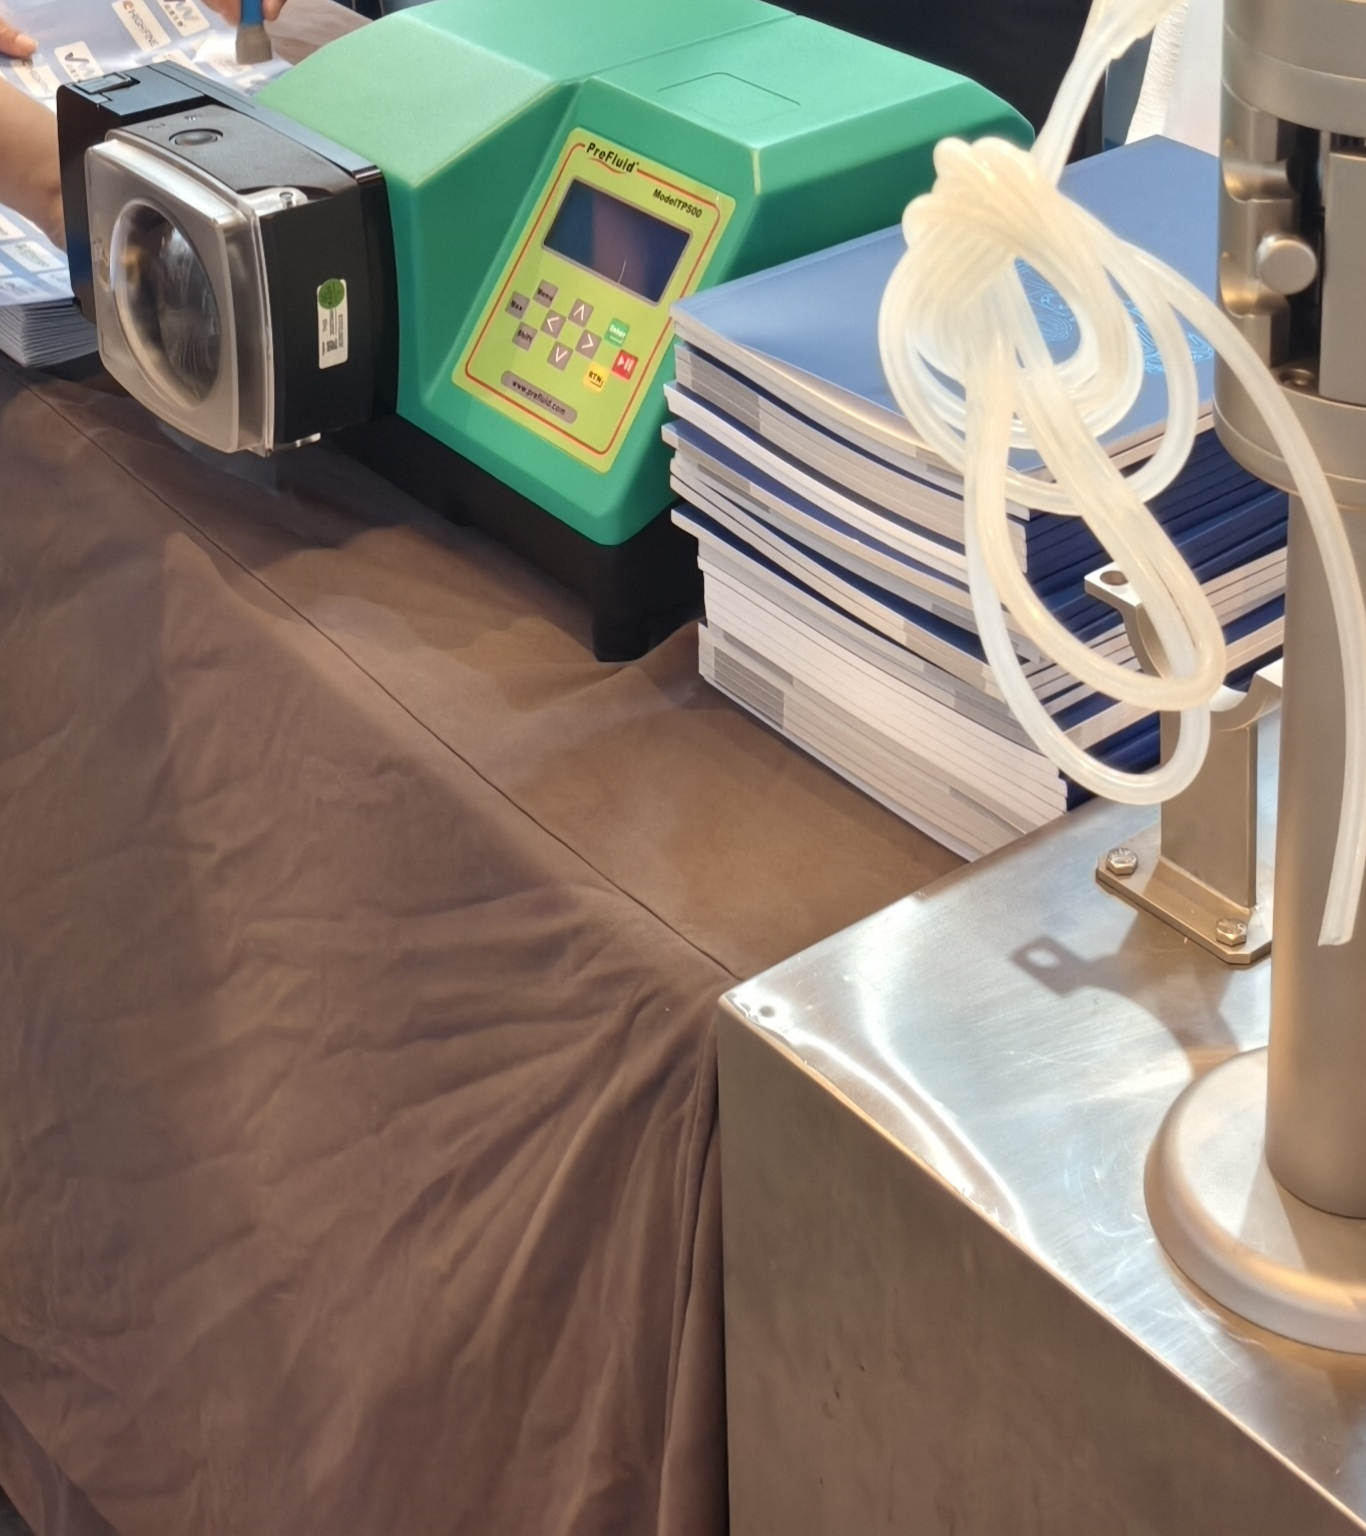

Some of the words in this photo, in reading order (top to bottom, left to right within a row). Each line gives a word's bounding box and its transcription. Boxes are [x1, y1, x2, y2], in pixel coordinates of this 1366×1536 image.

[586, 142, 636, 173] PreFluid
[609, 324, 626, 339] Enter
[588, 370, 603, 384] RTN
[512, 380, 566, 415] www.prefluid.com
